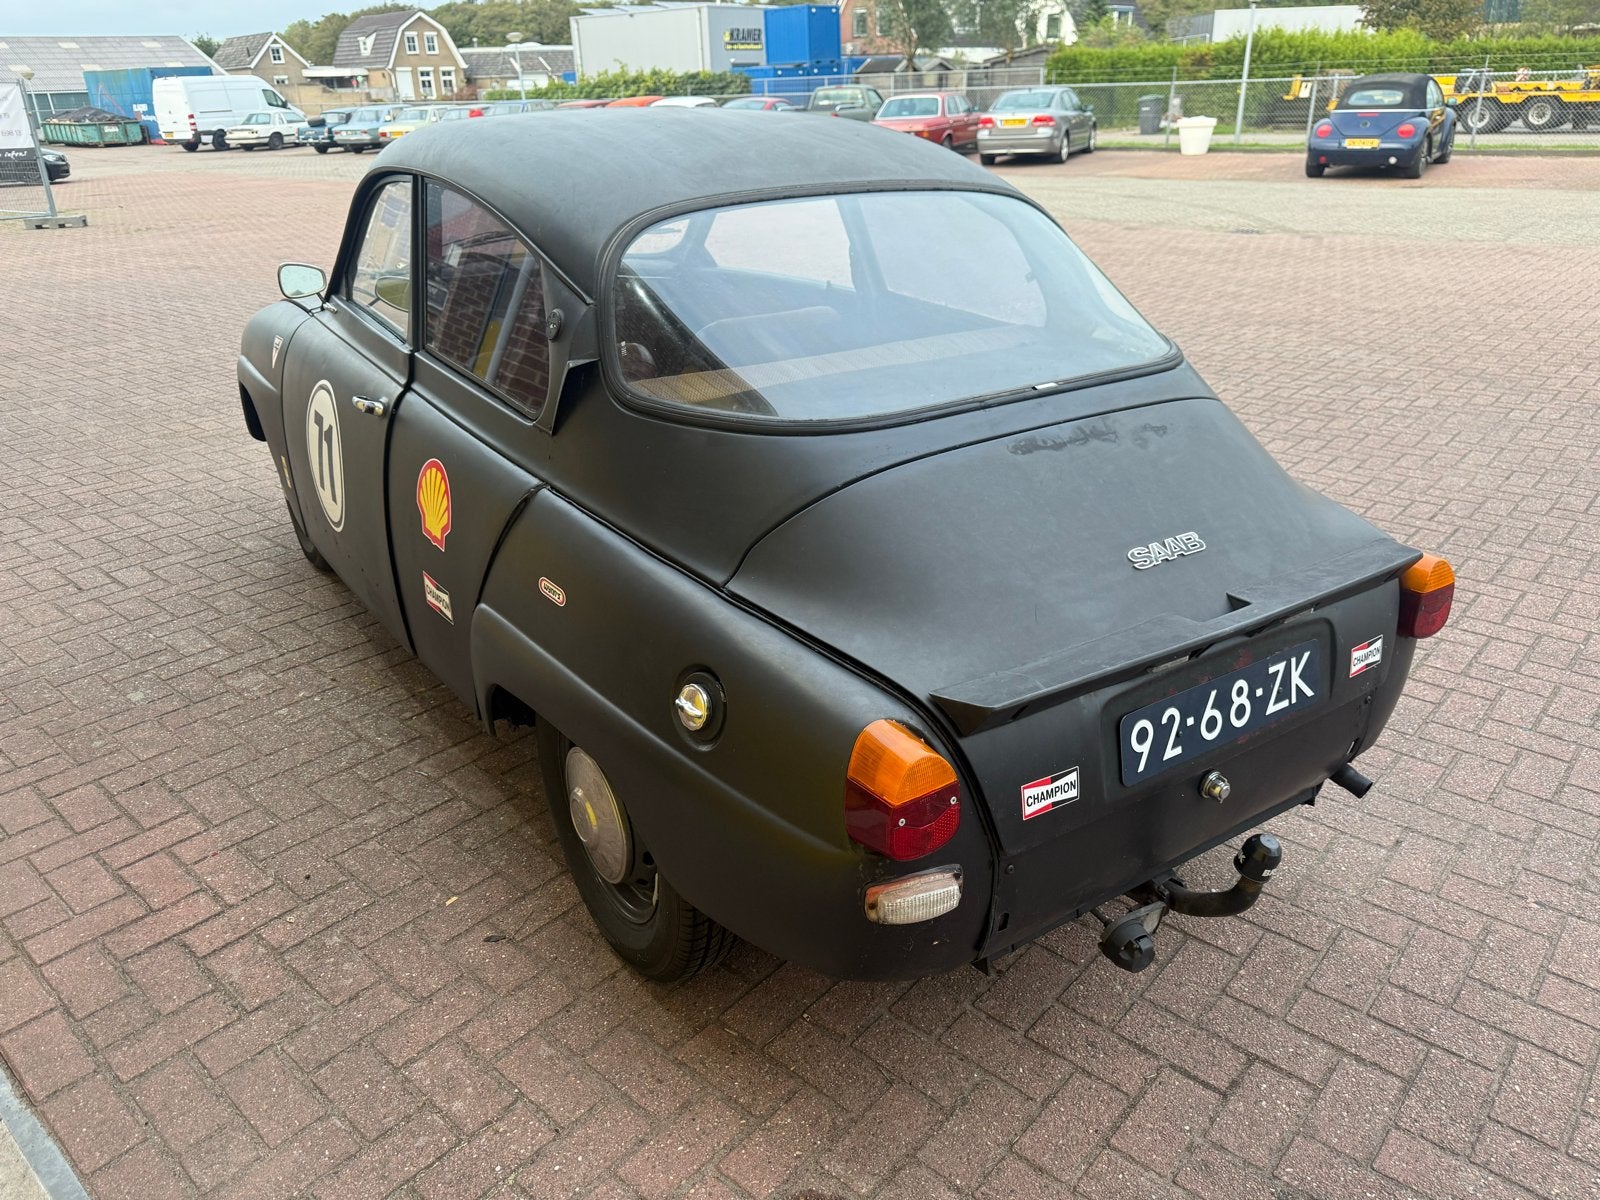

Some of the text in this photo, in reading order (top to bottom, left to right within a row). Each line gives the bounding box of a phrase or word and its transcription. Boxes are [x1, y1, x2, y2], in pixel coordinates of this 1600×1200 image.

[1127, 531, 1206, 570] SAAB
[425, 583, 450, 612] CHAMPION
[1353, 646, 1381, 667] CHAMPION
[1026, 779, 1077, 807] CHAMPION
